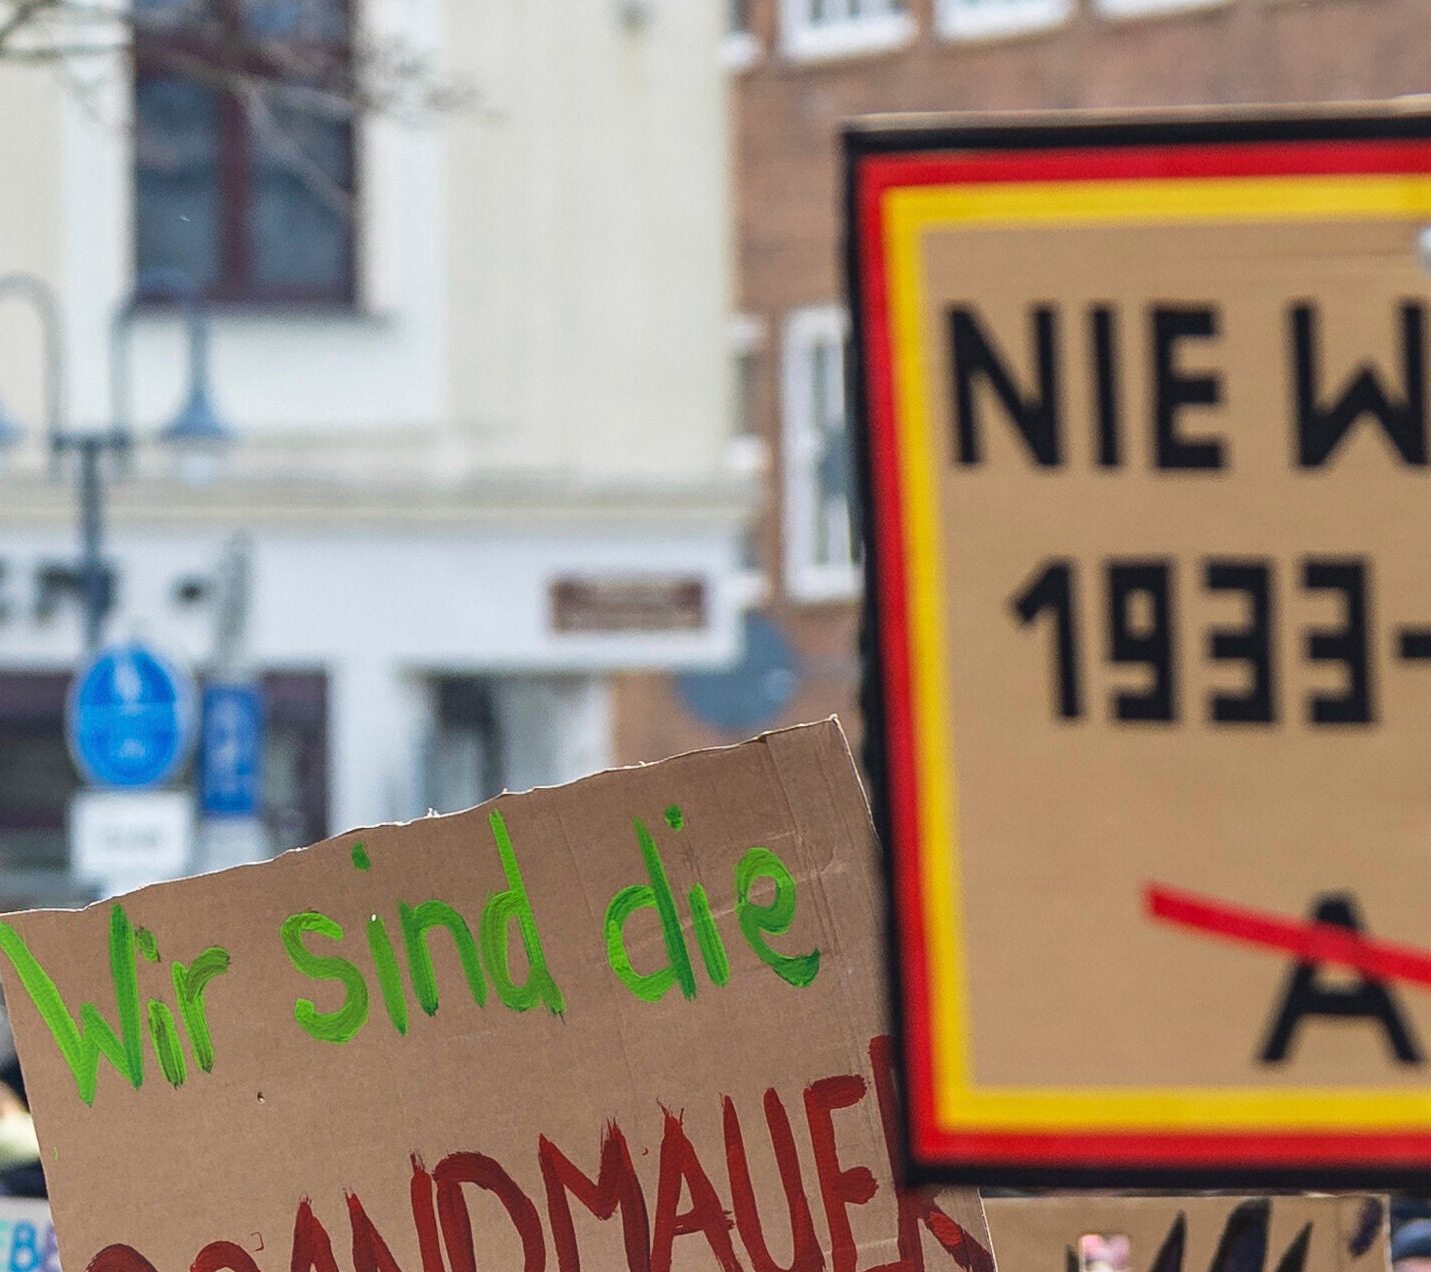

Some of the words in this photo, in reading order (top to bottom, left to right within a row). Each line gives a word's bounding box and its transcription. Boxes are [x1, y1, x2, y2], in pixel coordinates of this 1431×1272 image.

[944, 302, 1228, 471] NIE
[280, 808, 567, 1045] sind
[604, 805, 821, 1000] die
